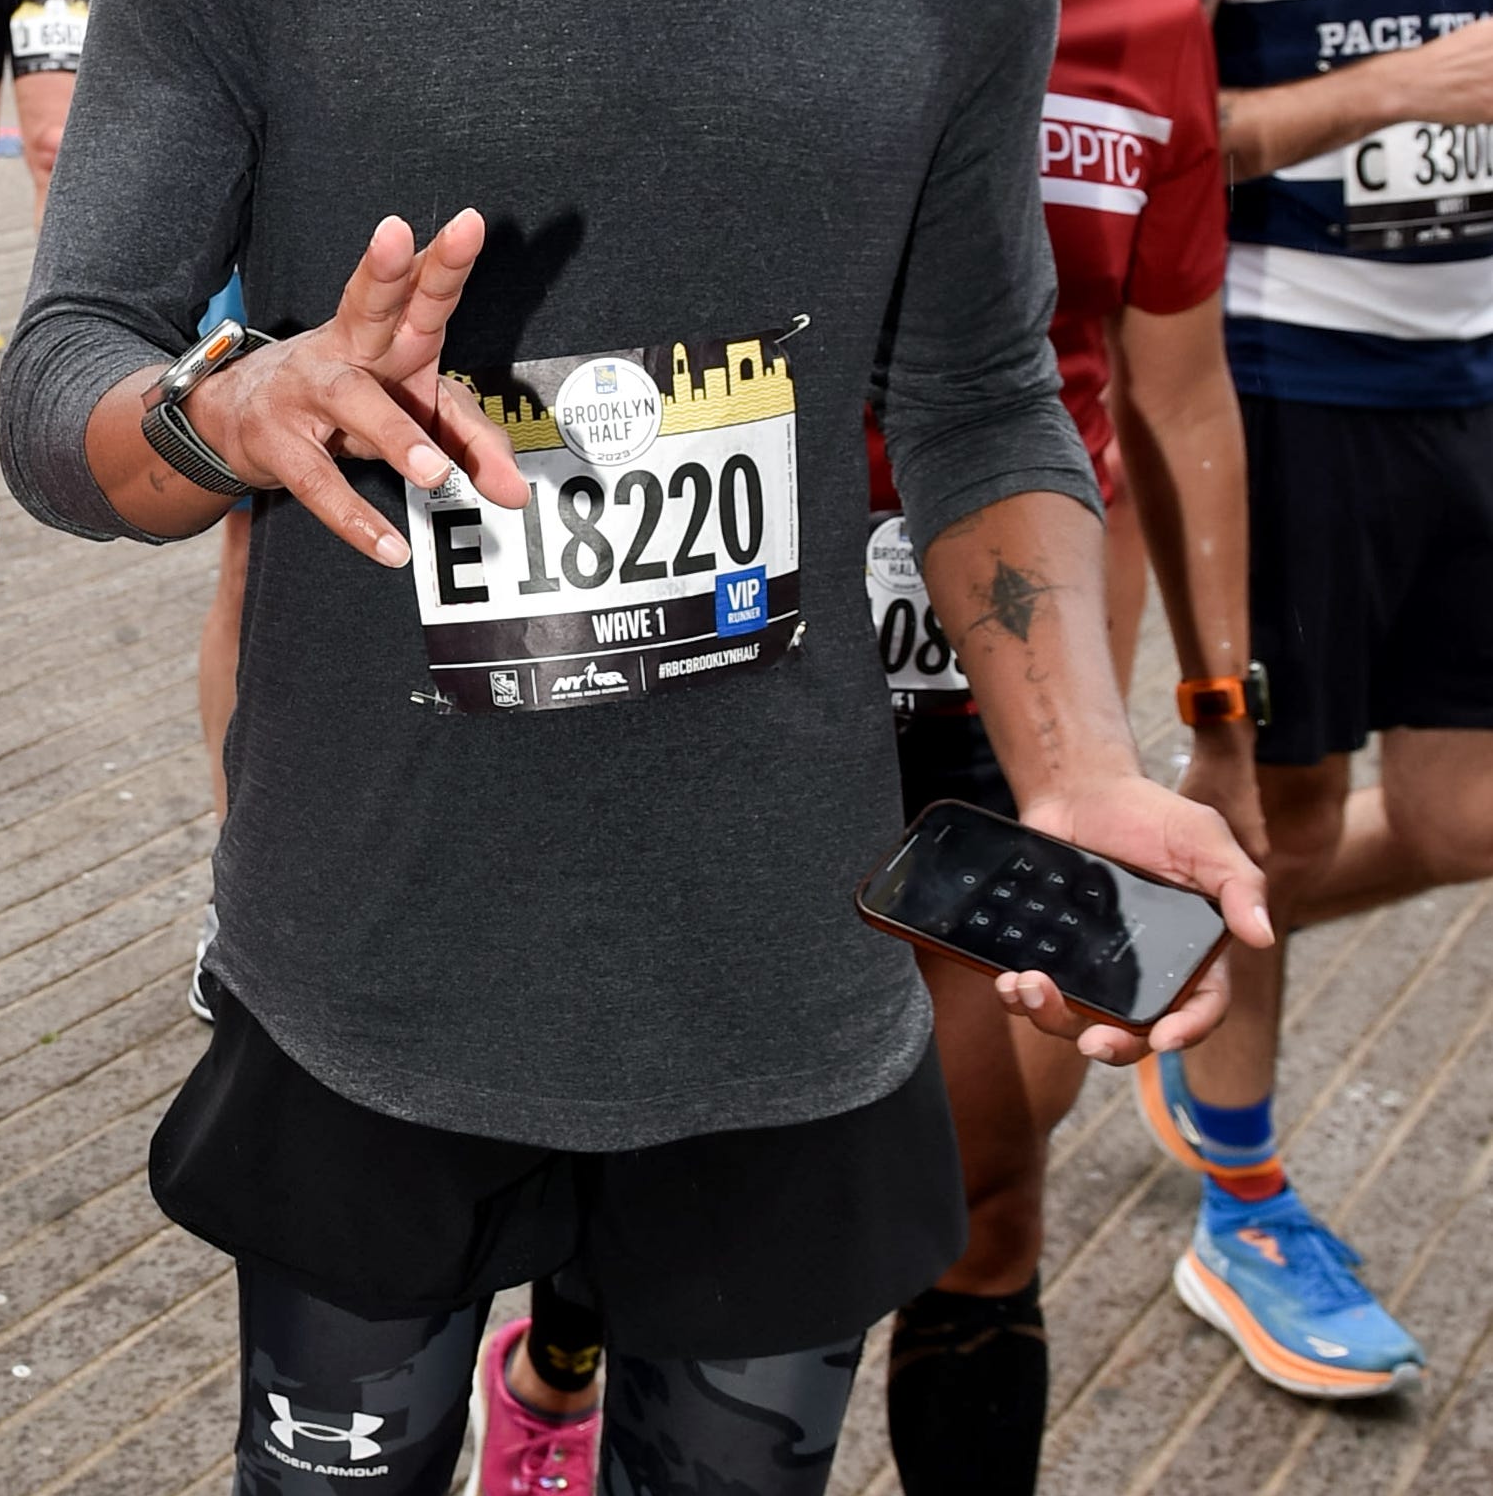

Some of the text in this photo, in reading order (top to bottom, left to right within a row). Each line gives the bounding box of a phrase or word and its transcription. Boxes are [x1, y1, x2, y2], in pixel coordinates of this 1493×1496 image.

[1316, 14, 1423, 56] PACE
[1040, 121, 1143, 187] PPTC
[1356, 142, 1387, 191] C
[563, 397, 655, 425] BROOKLYN
[589, 421, 632, 443] HALF
[597, 450, 630, 461] 2023
[431, 453, 764, 604] E 18220
[727, 578, 760, 610] VIP
[592, 607, 666, 644] WAVE 1
[727, 606, 761, 624] RUNNER
[658, 642, 760, 679] #RBCBROOKLYNHALF
[264, 1439, 389, 1477] UNDER ARMOUR
